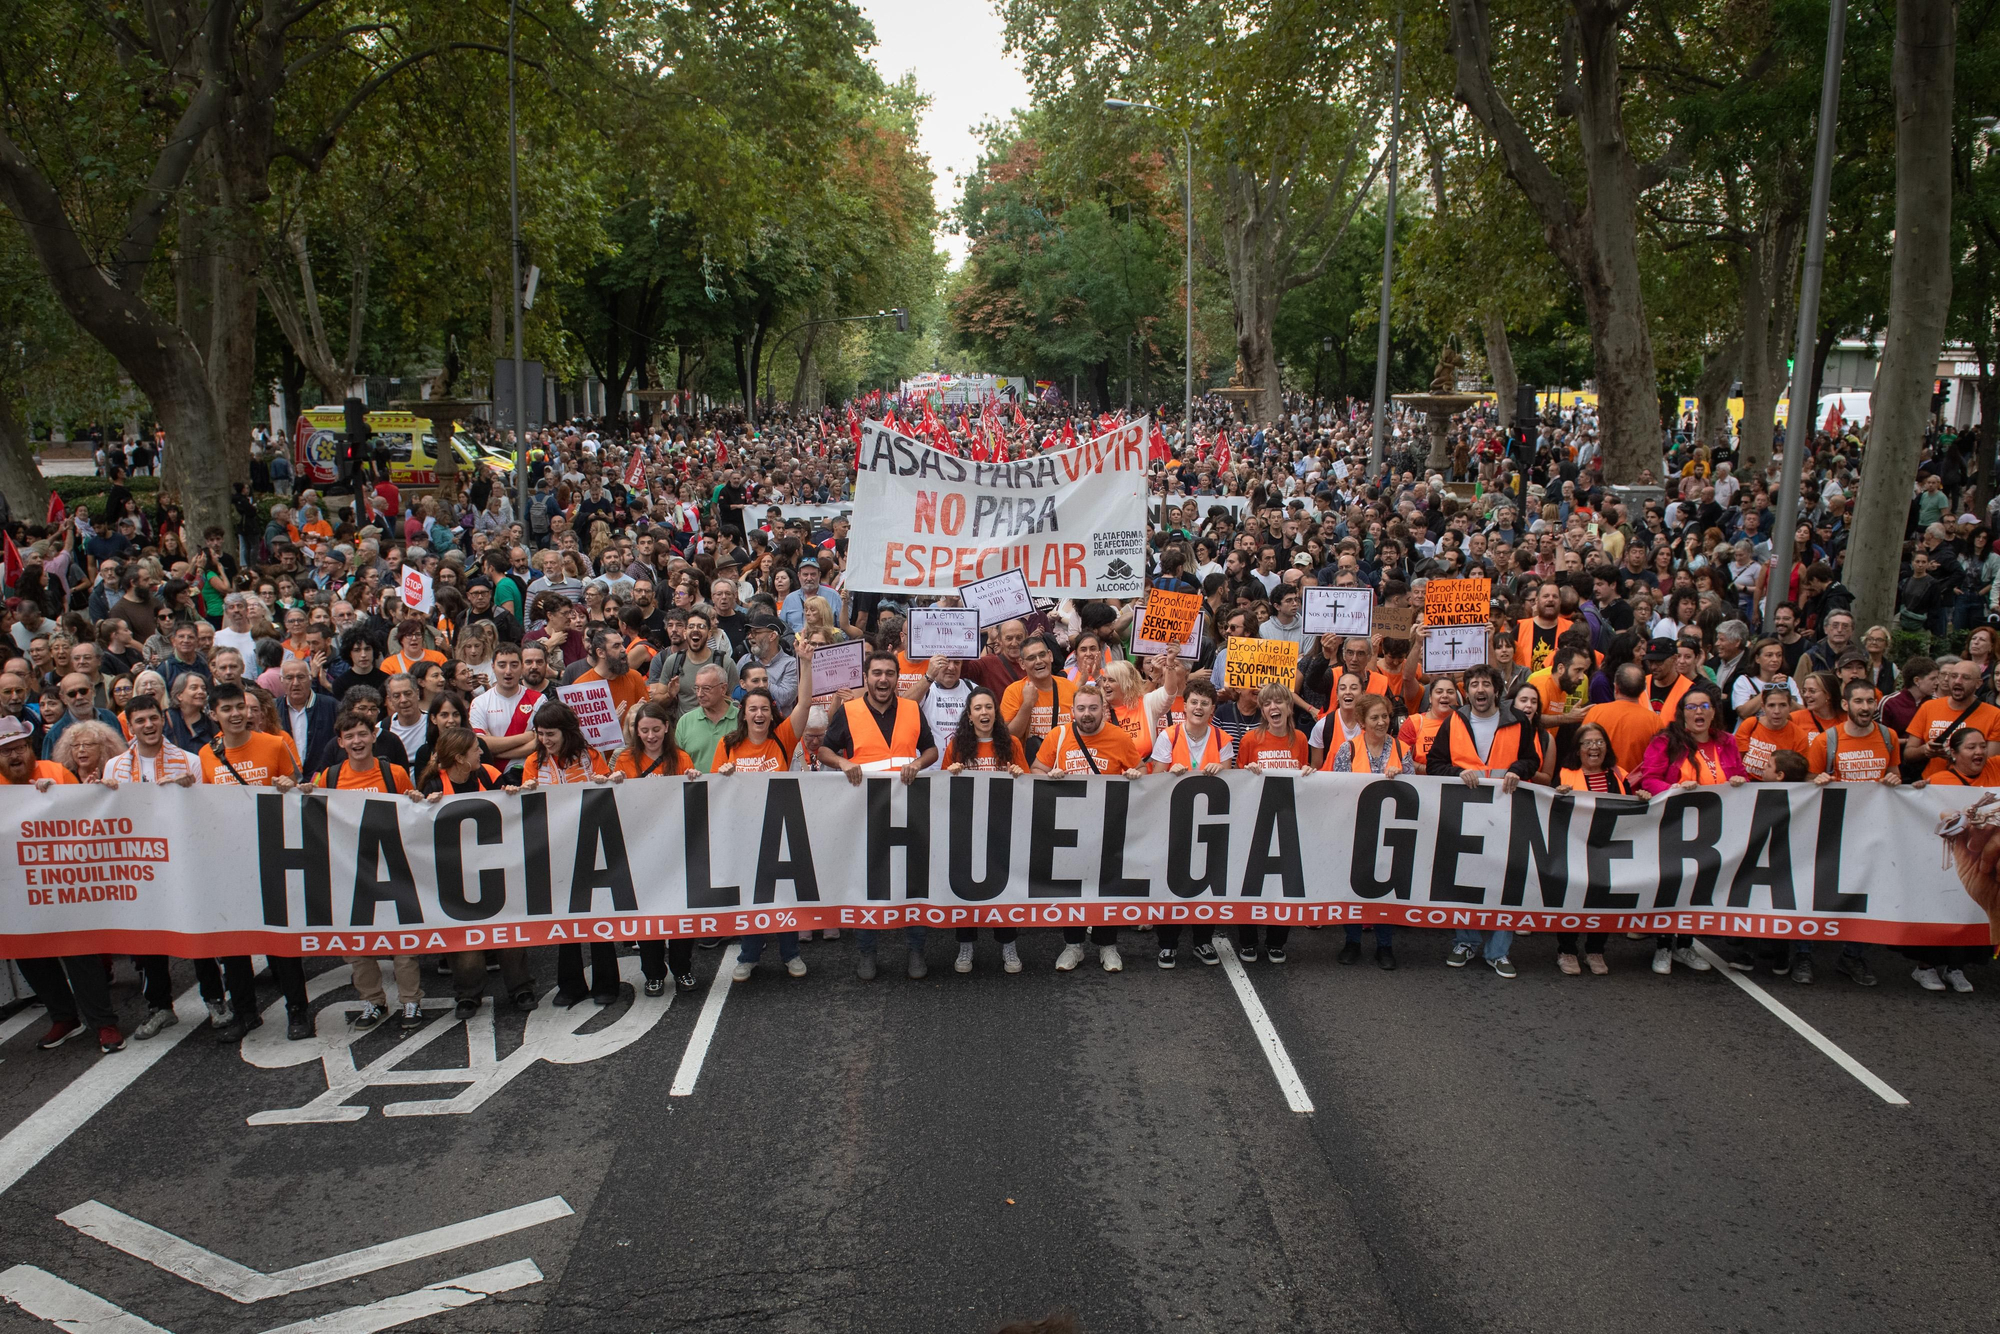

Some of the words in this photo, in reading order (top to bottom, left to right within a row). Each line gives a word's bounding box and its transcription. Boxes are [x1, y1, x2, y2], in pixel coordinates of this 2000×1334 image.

[974, 455, 1060, 489] PARA
[1057, 425, 1148, 483] VIVIR
[914, 490, 966, 536] NO
[972, 495, 1059, 538] PARA
[1093, 531, 1143, 541] PLATAFORMA
[1094, 542, 1102, 550] DE
[1103, 539, 1143, 549] AFECTADOS
[882, 541, 1087, 588] ESPECULAR
[406, 577, 422, 590] STOP
[987, 577, 1011, 590] emvs
[1096, 581, 1143, 592] ALCORCÓN
[988, 596, 1005, 606] VIDA
[1426, 593, 1454, 603] VUELVE
[1455, 593, 1461, 602] A
[1150, 605, 1167, 617] TUS
[1351, 611, 1366, 619] VIDA
[1426, 603, 1452, 615] ESTAS
[1455, 602, 1482, 613] CASAS
[1144, 615, 1182, 632] SEREMOS
[1183, 622, 1191, 632] TU
[1427, 615, 1445, 626] SON
[1448, 613, 1489, 625] NUESTRAS
[937, 627, 953, 635] VIDA
[1141, 627, 1166, 641] PEOR
[814, 652, 824, 660] LA
[826, 646, 851, 657] emvs
[1468, 647, 1482, 655] VIDA
[1228, 651, 1244, 661] VAS
[1249, 653, 1255, 662] A
[1258, 653, 1296, 667] COMPRAR
[1227, 661, 1255, 674] 5300
[1256, 663, 1296, 679] FAMILIAS
[1230, 673, 1246, 687] EN
[563, 691, 584, 704] POR
[586, 687, 607, 700] UNA
[571, 700, 608, 716] HUELGA
[579, 712, 614, 727] ENERAL
[1040, 715, 1071, 724] INQUNAS
[1931, 720, 1966, 729] SINDIO
[588, 727, 601, 738] YA
[1066, 748, 1098, 759] SINDITO
[1257, 750, 1292, 759] SINDICATO
[1838, 750, 1874, 760] SINDICATO
[736, 755, 766, 766] SINDICA
[1067, 760, 1075, 769] DE
[1076, 758, 1107, 769] INQUNAS
[1840, 762, 1849, 770] DE
[1850, 759, 1885, 769] INQUILINAS
[214, 760, 253, 775] SINCATO
[216, 776, 225, 784] DE
[225, 768, 267, 784] INQILINAS
[20, 817, 133, 838] SINDICATO
[23, 844, 51, 863] DE
[53, 841, 166, 862] INQUILINAS
[257, 787, 639, 927] HACIA
[683, 778, 821, 909] LA
[866, 775, 1306, 902] HUELGA
[1350, 780, 1868, 913] GENERAL
[25, 869, 38, 885] E
[41, 864, 155, 886] INQUILINOS
[28, 889, 54, 905] DE
[58, 884, 138, 904] MADRID
[301, 931, 448, 952] BAJADA
[465, 926, 531, 946] DEL
[547, 916, 718, 941] ALQUILER
[735, 911, 798, 930] 50%
[841, 904, 1085, 926] EXPROPIACIÓN
[1104, 905, 1235, 921] FONDOS
[1251, 905, 1364, 922] BUITRE
[1405, 909, 1601, 929] CONTRATOS
[1617, 914, 1841, 937] INDEFINIDOS
